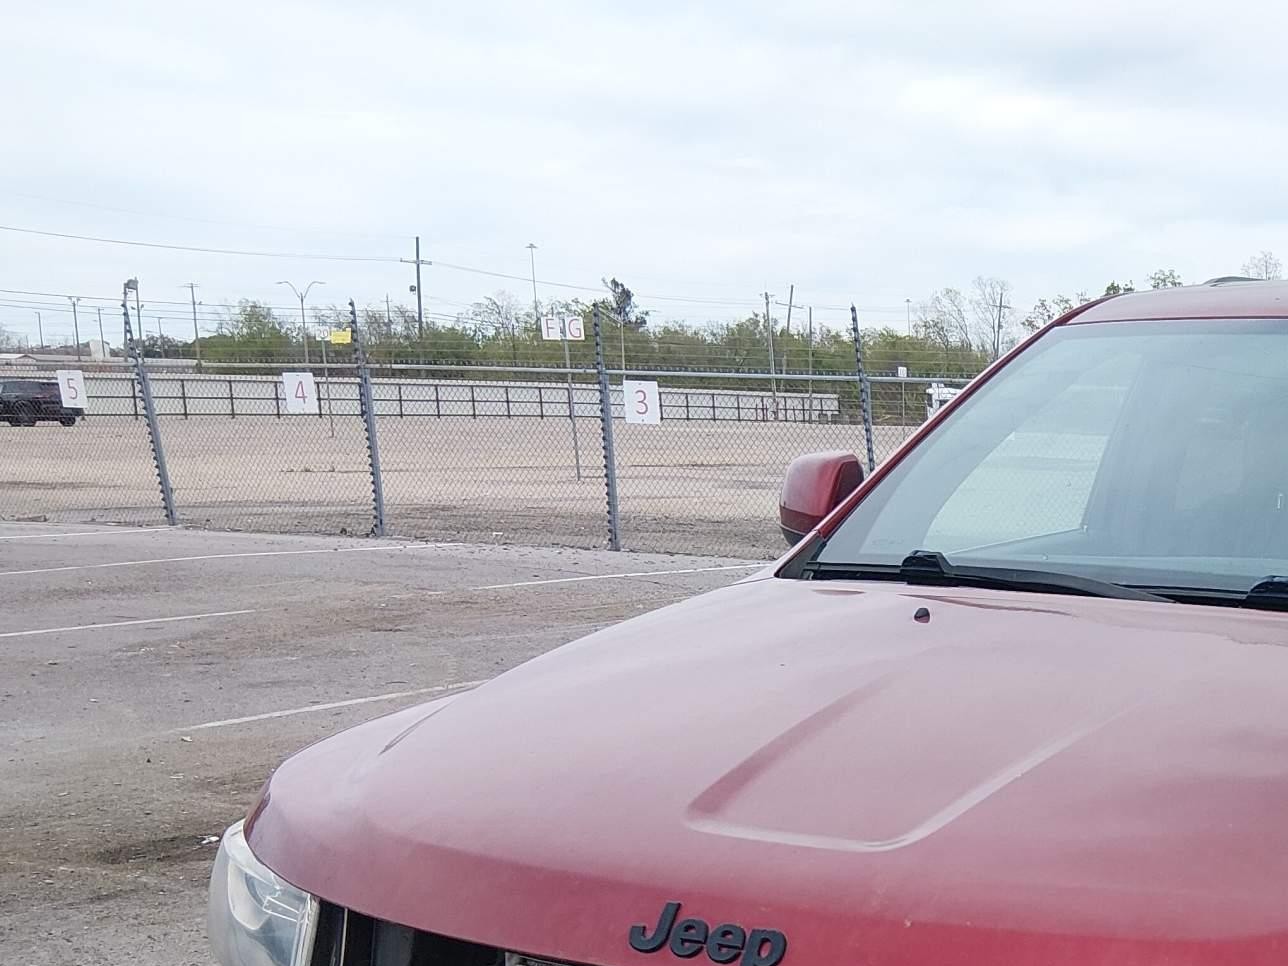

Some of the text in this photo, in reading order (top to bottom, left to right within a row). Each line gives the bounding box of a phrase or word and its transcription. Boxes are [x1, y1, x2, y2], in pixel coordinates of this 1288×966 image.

[545, 318, 555, 338] F
[568, 318, 582, 339] G
[66, 377, 78, 400] 5
[294, 380, 308, 404] 4
[634, 389, 649, 415] 3
